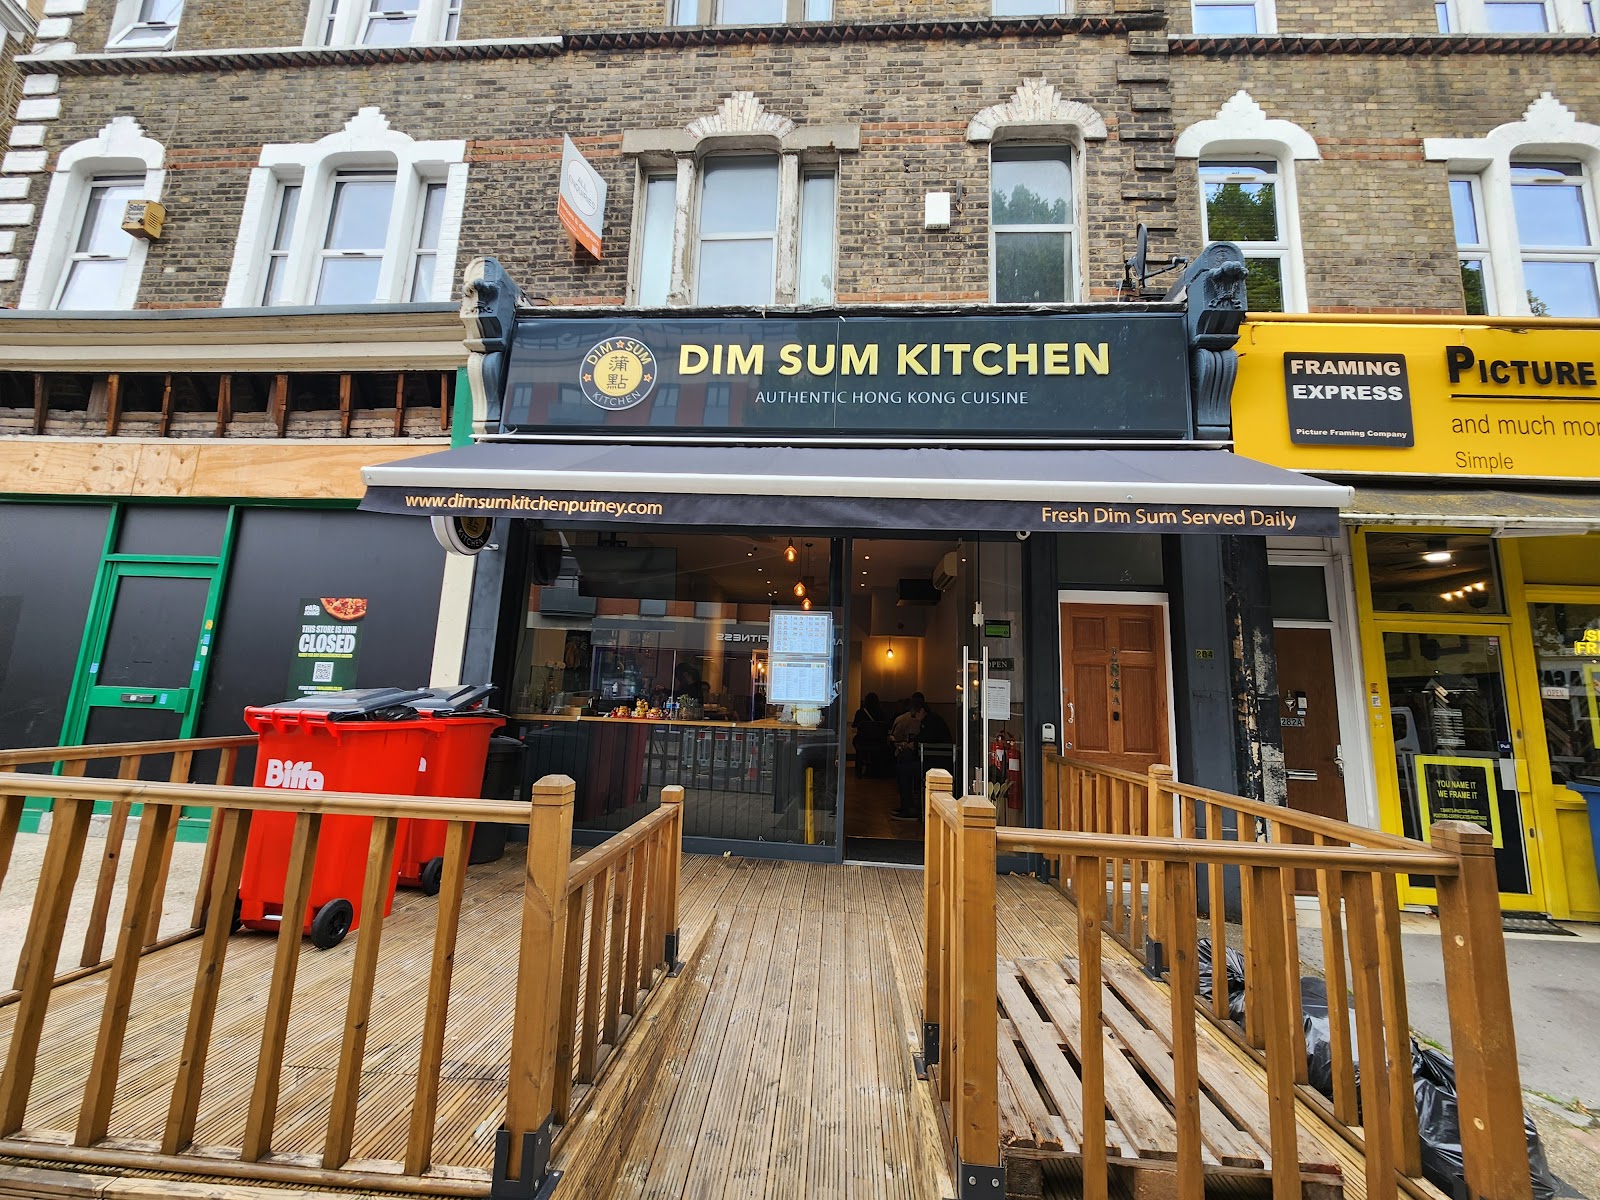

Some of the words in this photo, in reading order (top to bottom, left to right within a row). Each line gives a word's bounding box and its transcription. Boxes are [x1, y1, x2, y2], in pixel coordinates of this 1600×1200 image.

[586, 341, 613, 366] DIM
[625, 340, 652, 365] SUM
[678, 344, 764, 375] DIM
[778, 343, 878, 376] SUM
[897, 343, 1109, 376] KITCHEN
[1290, 359, 1401, 376] FRAMING
[1445, 345, 1598, 386] PICTURE
[592, 390, 641, 406] KITCHEN
[755, 391, 847, 404] AUTHENTIC
[853, 391, 901, 404] HONG
[908, 391, 956, 404] KONG
[961, 391, 1029, 404] CUISINE
[1292, 384, 1403, 401] EXPRESS
[1451, 413, 1490, 434] and
[1497, 415, 1556, 435] much
[1296, 428, 1328, 436] Picture
[1330, 429, 1365, 438] Framing
[1367, 430, 1407, 439] Company
[1455, 450, 1514, 473] Simple
[405, 493, 663, 517] www.dimsumkitchenputney.com
[1041, 507, 1089, 523] Fresh
[1094, 507, 1131, 524] Dim
[1136, 507, 1177, 525] Sum
[1181, 508, 1245, 526] Served
[1250, 510, 1297, 531] Daily
[458, 528, 484, 547] KITCHEN
[302, 625, 316, 633] THIS
[316, 625, 335, 633] STORE
[335, 625, 342, 633] IS
[342, 626, 357, 634] NOW
[299, 634, 355, 653] CLOSED
[1575, 641, 1600, 655] FR
[1546, 688, 1564, 697] OPEN
[1281, 718, 1303, 726] 282A
[264, 758, 325, 791] Biffa
[1437, 780, 1450, 788] YOU
[1451, 780, 1470, 789] NAME
[1471, 781, 1476, 789] IT
[1437, 790, 1449, 798] WE
[1449, 790, 1471, 799] FRAME
